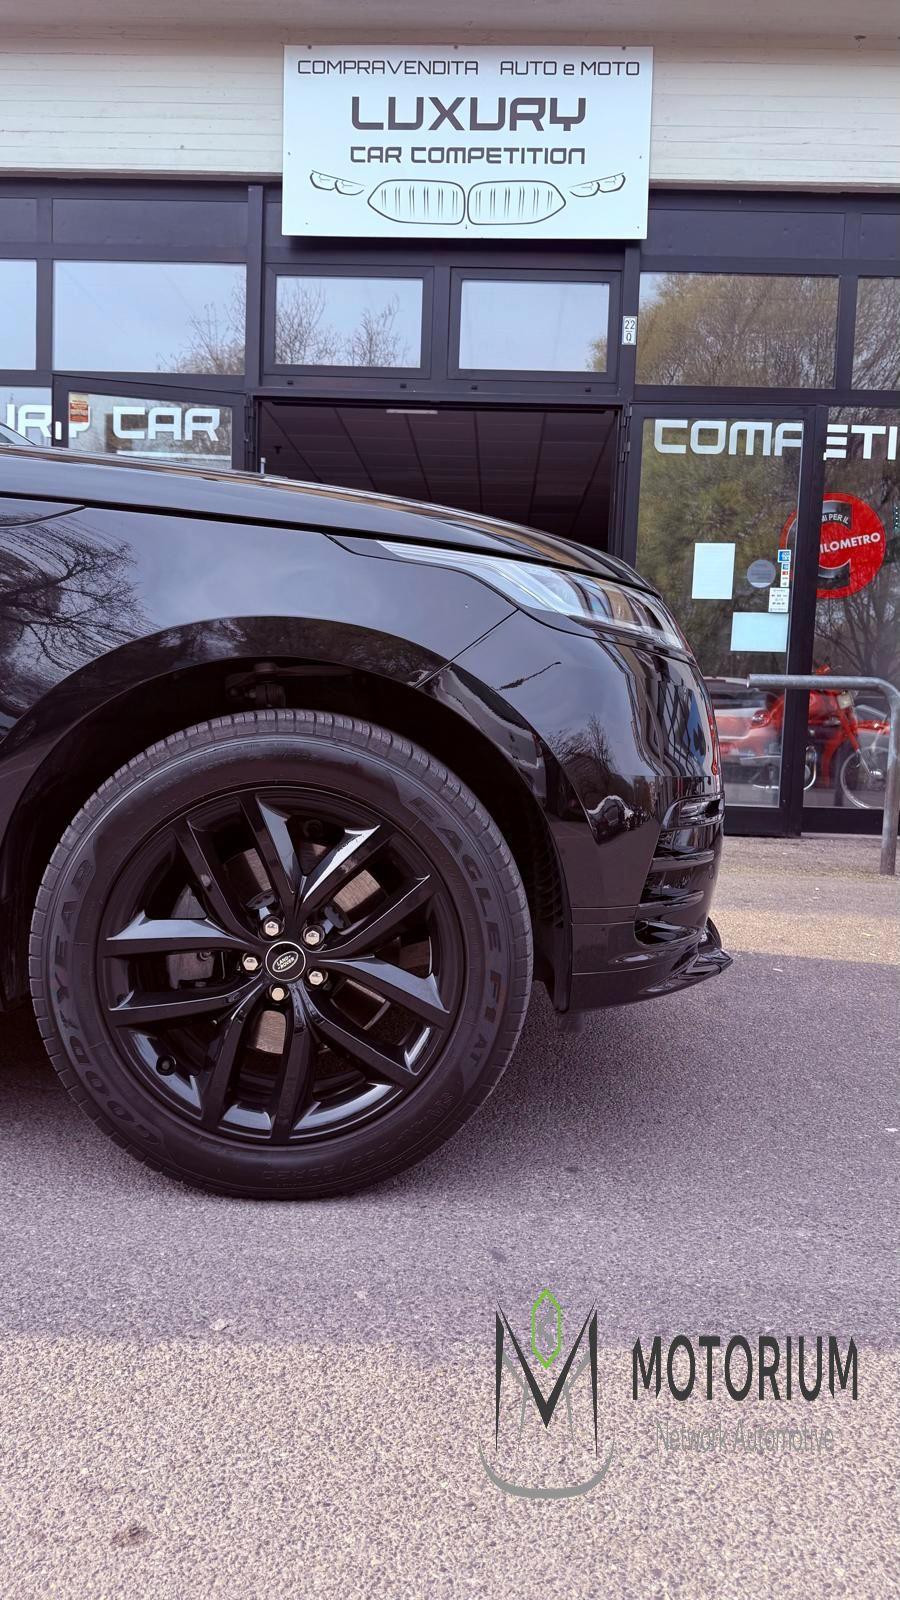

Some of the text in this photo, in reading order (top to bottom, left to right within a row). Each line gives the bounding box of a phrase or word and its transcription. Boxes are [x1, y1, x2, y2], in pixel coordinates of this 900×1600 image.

[297, 59, 640, 76] COMPRAVENDITA AUTO e MOTO
[351, 96, 586, 132] LUXURY
[350, 146, 585, 165] CAR COMPETITION
[624, 319, 635, 330] 22
[113, 406, 220, 441] CAR
[828, 513, 843, 522] PER
[820, 532, 881, 553] ILOMETRO
[409, 796, 501, 953] EAGLE
